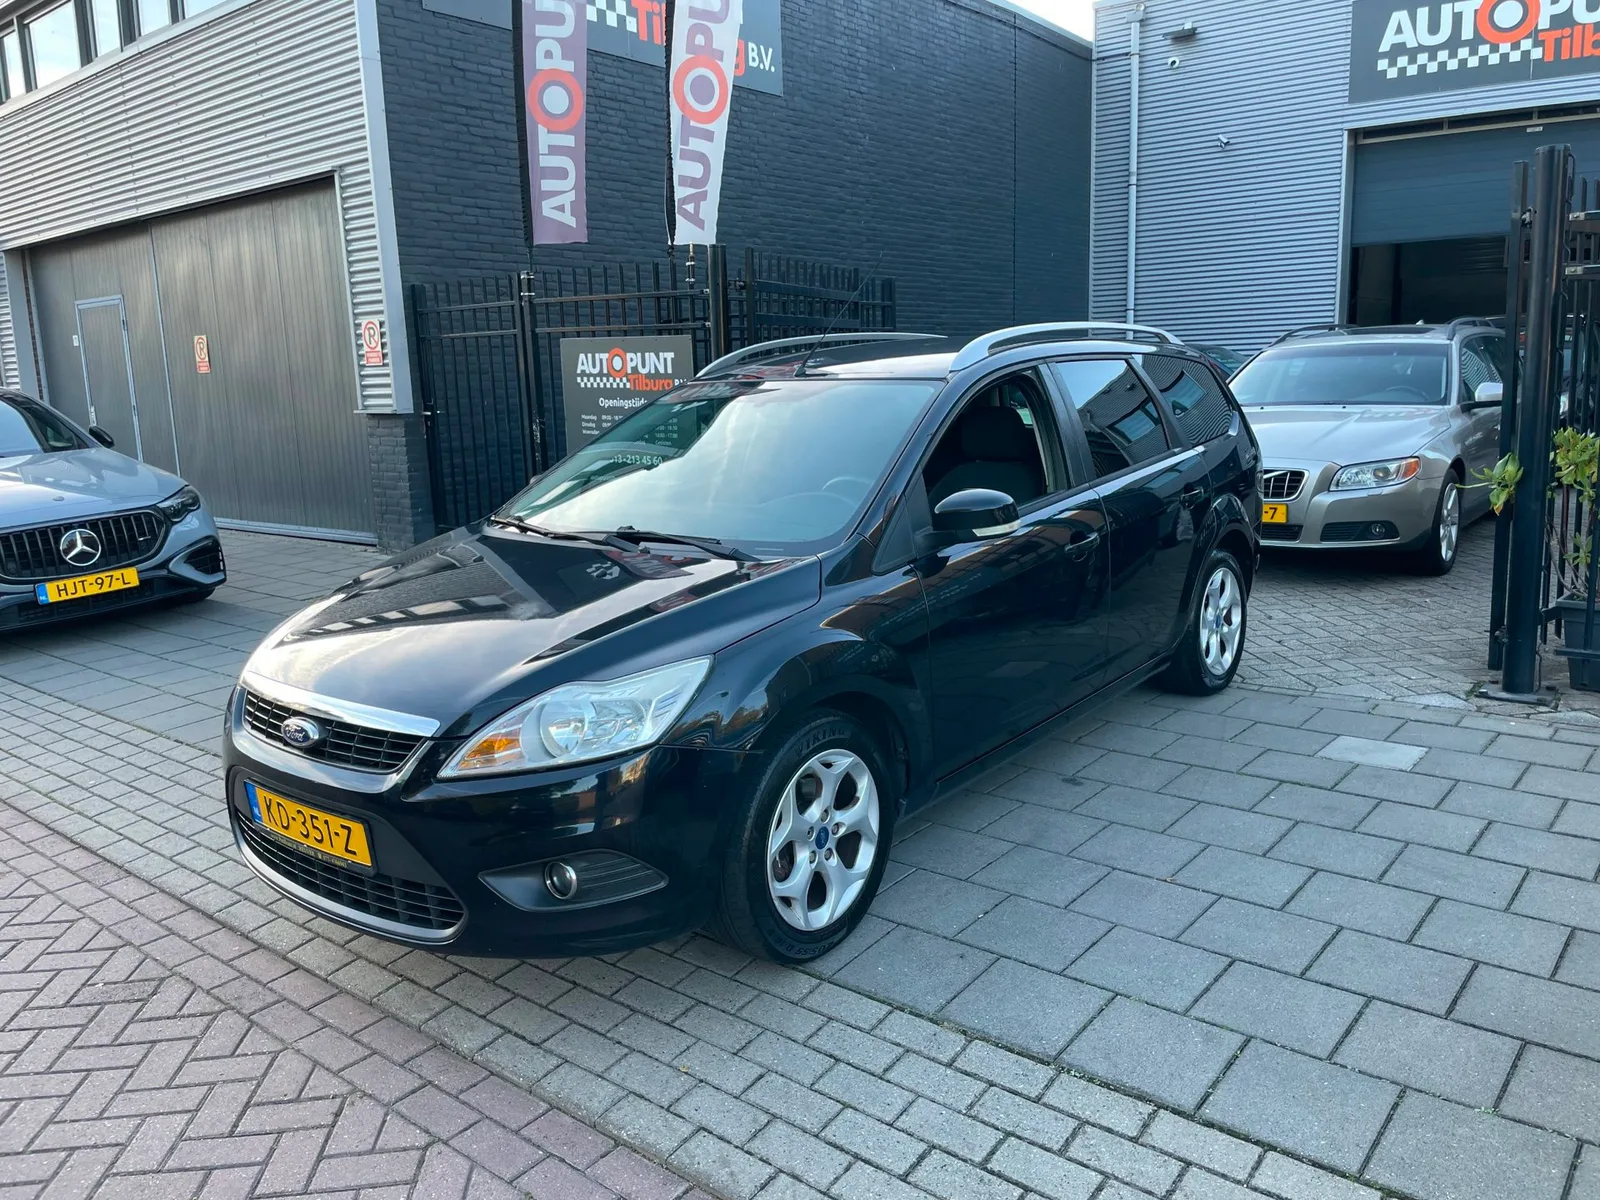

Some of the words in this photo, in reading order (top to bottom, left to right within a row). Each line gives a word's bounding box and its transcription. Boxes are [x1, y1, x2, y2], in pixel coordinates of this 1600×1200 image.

[748, 42, 775, 72] B.V.
[576, 347, 675, 378] AUTOPUNT
[641, 456, 652, 465] 45
[56, 573, 131, 598] HJT-97-L
[286, 724, 306, 742] Ford
[264, 795, 358, 856] KD-351-Z
